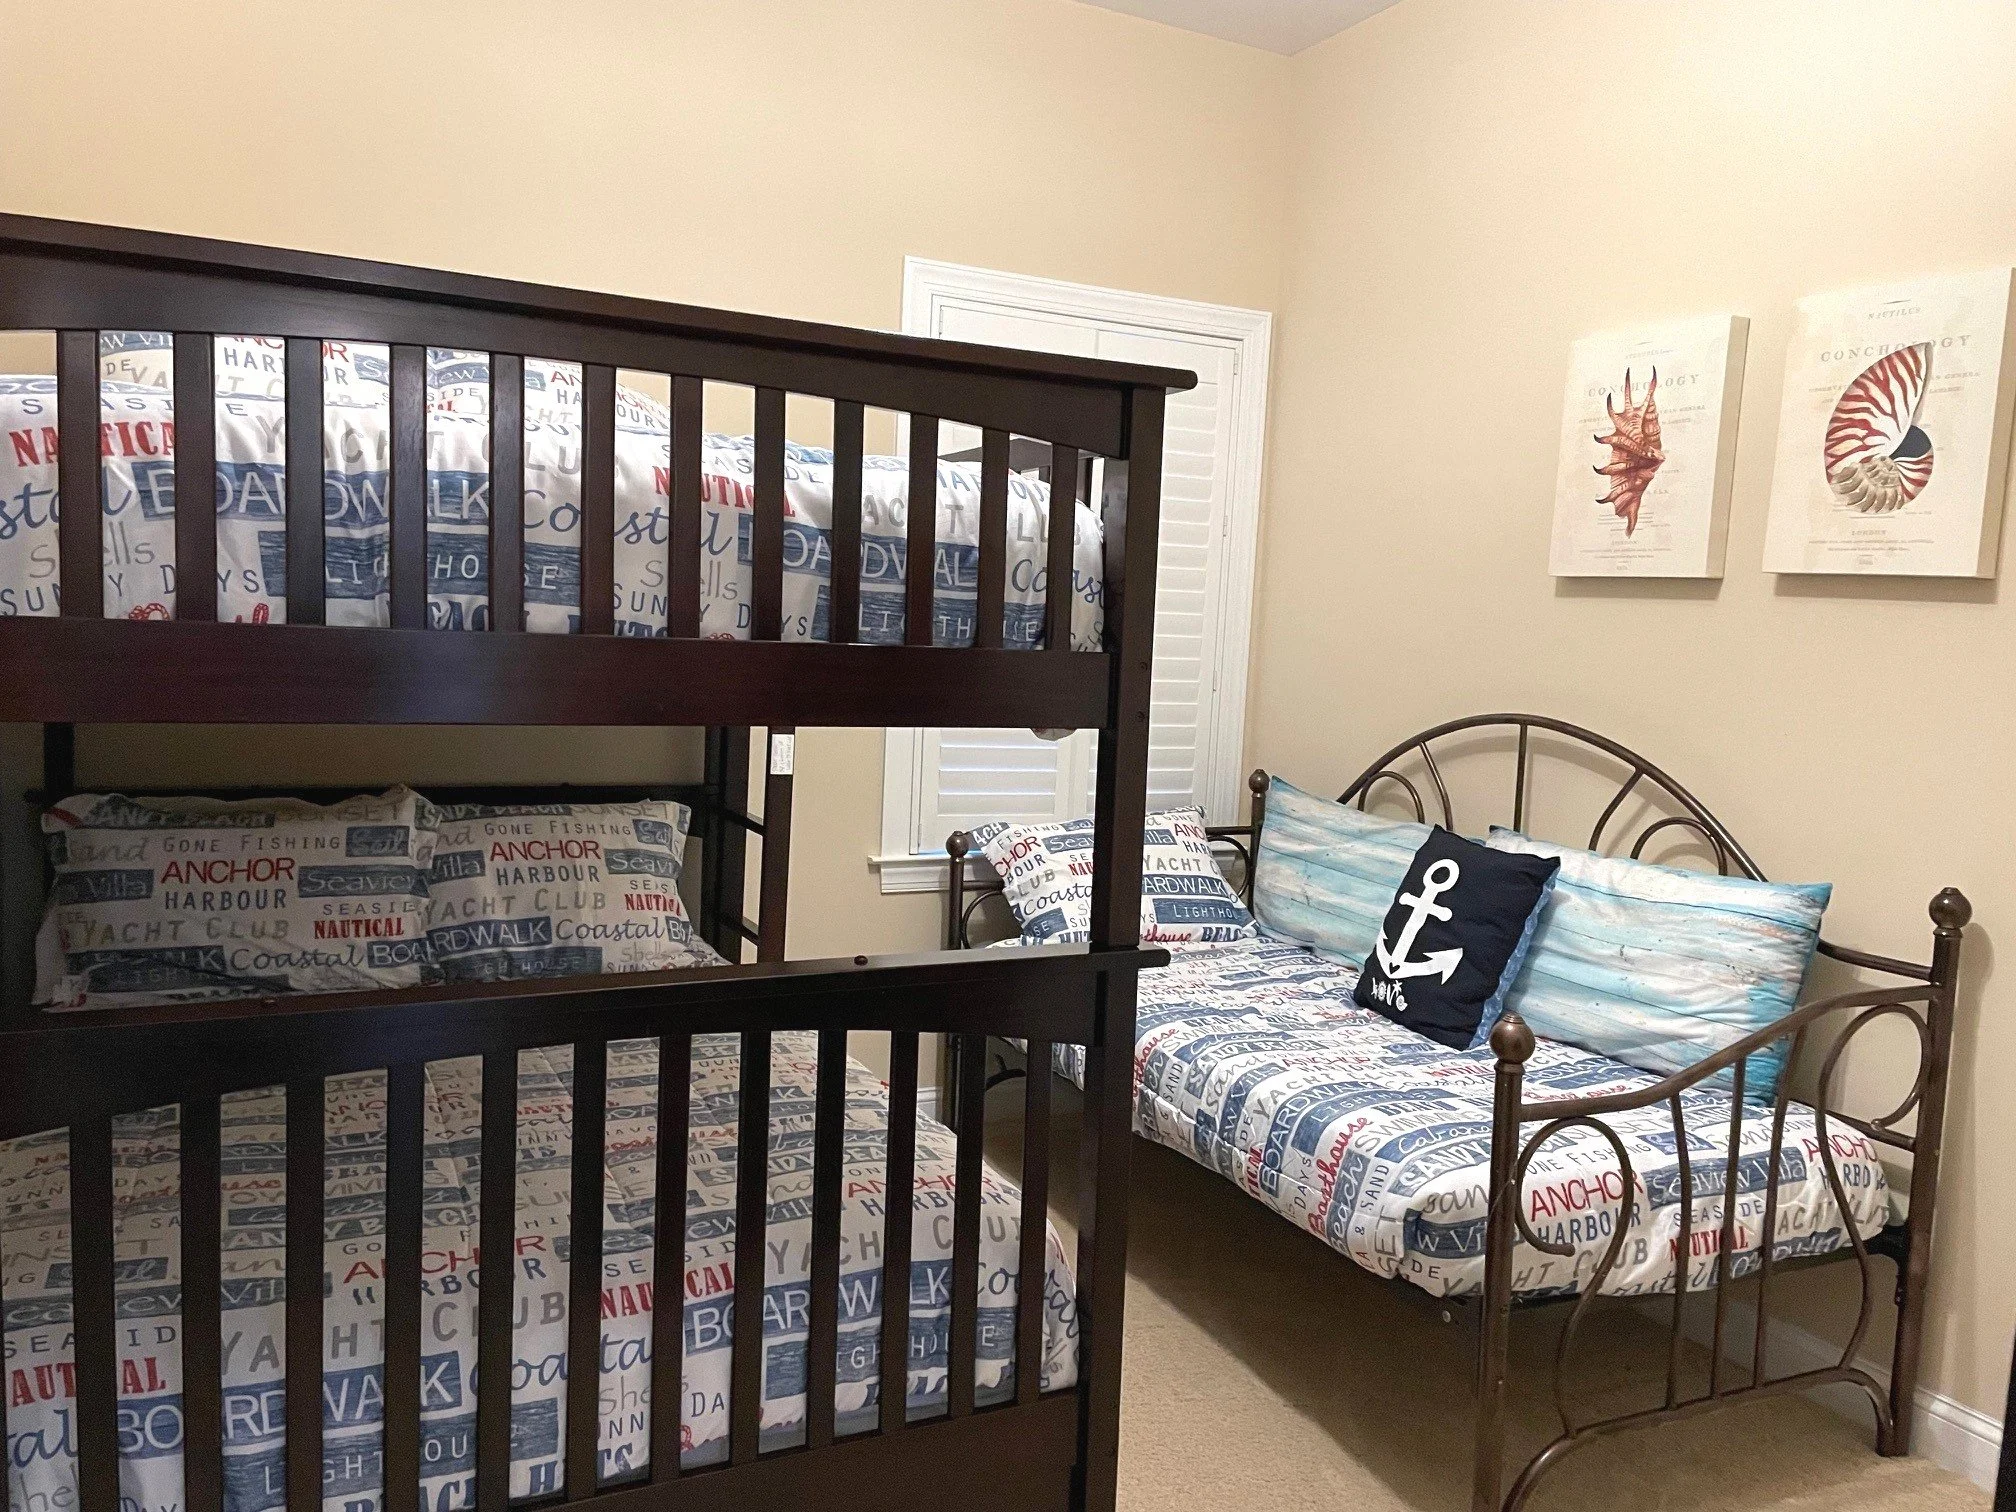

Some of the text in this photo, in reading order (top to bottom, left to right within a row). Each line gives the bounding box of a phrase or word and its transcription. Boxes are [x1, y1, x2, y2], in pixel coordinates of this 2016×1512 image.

[223, 346, 348, 386] HARR
[1820, 334, 1972, 362] CONCHOGY
[1588, 374, 1699, 398] COHOOGY
[557, 388, 655, 428] HAOUR
[9, 421, 174, 467] NATICA
[652, 465, 796, 518] NUTICL
[524, 489, 732, 556] Costl
[30, 521, 155, 579] Slls
[1, 573, 123, 616] SUY
[160, 564, 260, 595] DYS
[640, 560, 738, 600] Slls
[614, 583, 710, 623] SUNY
[737, 602, 808, 637] DYS
[163, 836, 220, 854] GONE
[240, 834, 341, 851] FISHING
[484, 822, 533, 837] GONE
[550, 821, 631, 837] FISHING
[996, 824, 1059, 850] FISHING
[490, 840, 601, 862] ANCHOR
[1142, 854, 1202, 872] YACHT
[89, 873, 149, 897] Villa
[160, 857, 296, 885] ANCHOR
[497, 865, 600, 886] HARBOUR
[1143, 876, 1227, 895] ARDWALK
[165, 888, 287, 911] HARBOUR
[535, 888, 606, 911] CLUB
[85, 917, 404, 946] YACHT CLUB NAUTICAL
[556, 917, 666, 941] Coastal
[230, 948, 366, 971] Coastal
[1162, 1063, 1184, 1103] SAND
[1262, 1080, 1375, 1192] BOARDWALK
[1566, 1143, 1652, 1166] FISHNG
[1706, 1123, 1774, 1152] Snd
[1569, 1117, 1670, 1141] SUSET
[848, 1173, 997, 1198] ANCHR
[1294, 1157, 1311, 1210] DAYS
[1360, 1163, 1390, 1211] SAND
[860, 1191, 1009, 1217] HRBR
[1538, 1198, 1766, 1244] HARBOR SEASDE
[229, 1222, 343, 1248] ANY
[343, 1235, 547, 1283] ACHR
[1444, 1262, 1554, 1297] YAHT
[1670, 1226, 1748, 1262] NUTIL
[602, 1262, 734, 1320] NAUCAL
[5, 1325, 176, 1359] SEAID
[221, 1291, 566, 1376] YAHT CB
[118, 1361, 454, 1454] BORDWAK
[470, 1334, 652, 1396] oata
[694, 1266, 949, 1350] BARWLK
[12, 1356, 166, 1407] AUTAL
